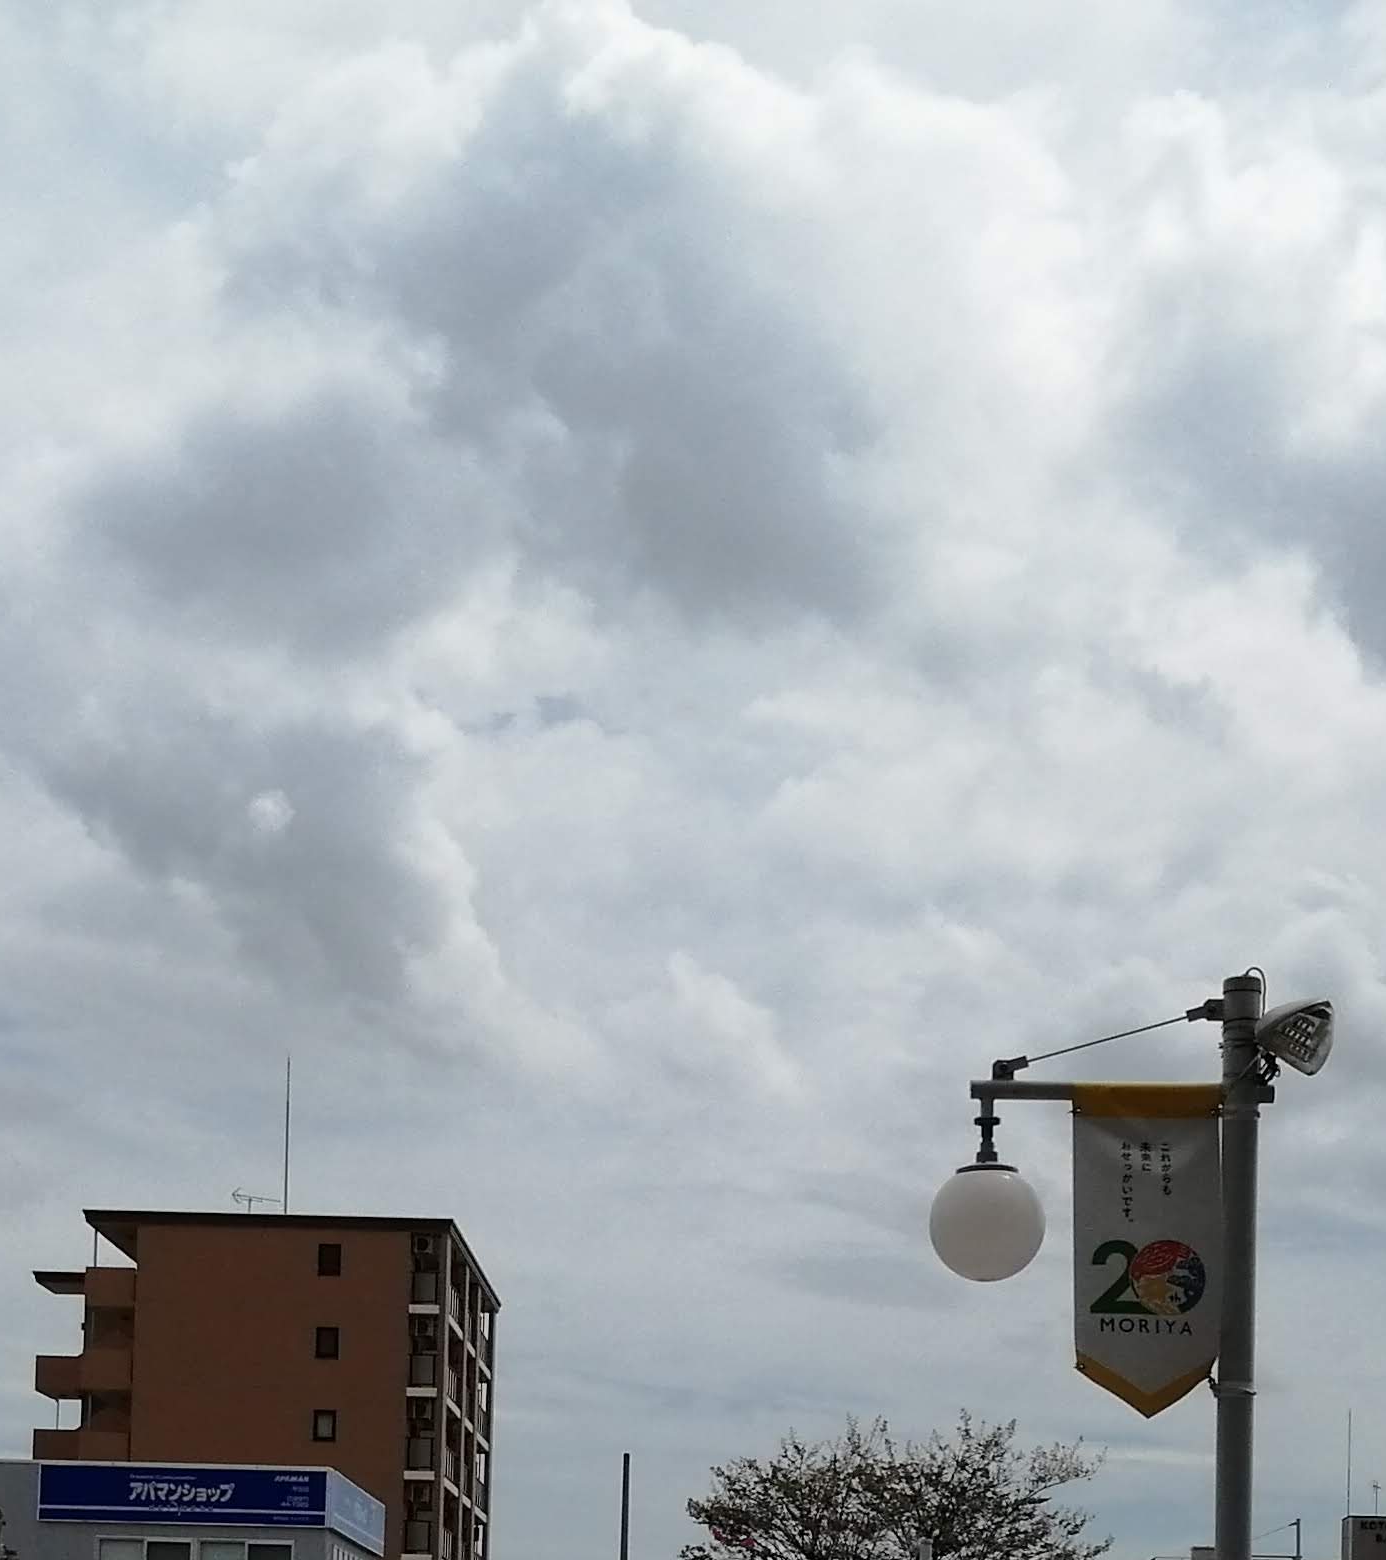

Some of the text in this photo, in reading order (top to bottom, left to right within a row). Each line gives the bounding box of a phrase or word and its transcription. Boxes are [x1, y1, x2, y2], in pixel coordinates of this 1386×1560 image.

[1100, 1318, 1193, 1336] MORIYA
[128, 1481, 236, 1503] アパマンショップ
